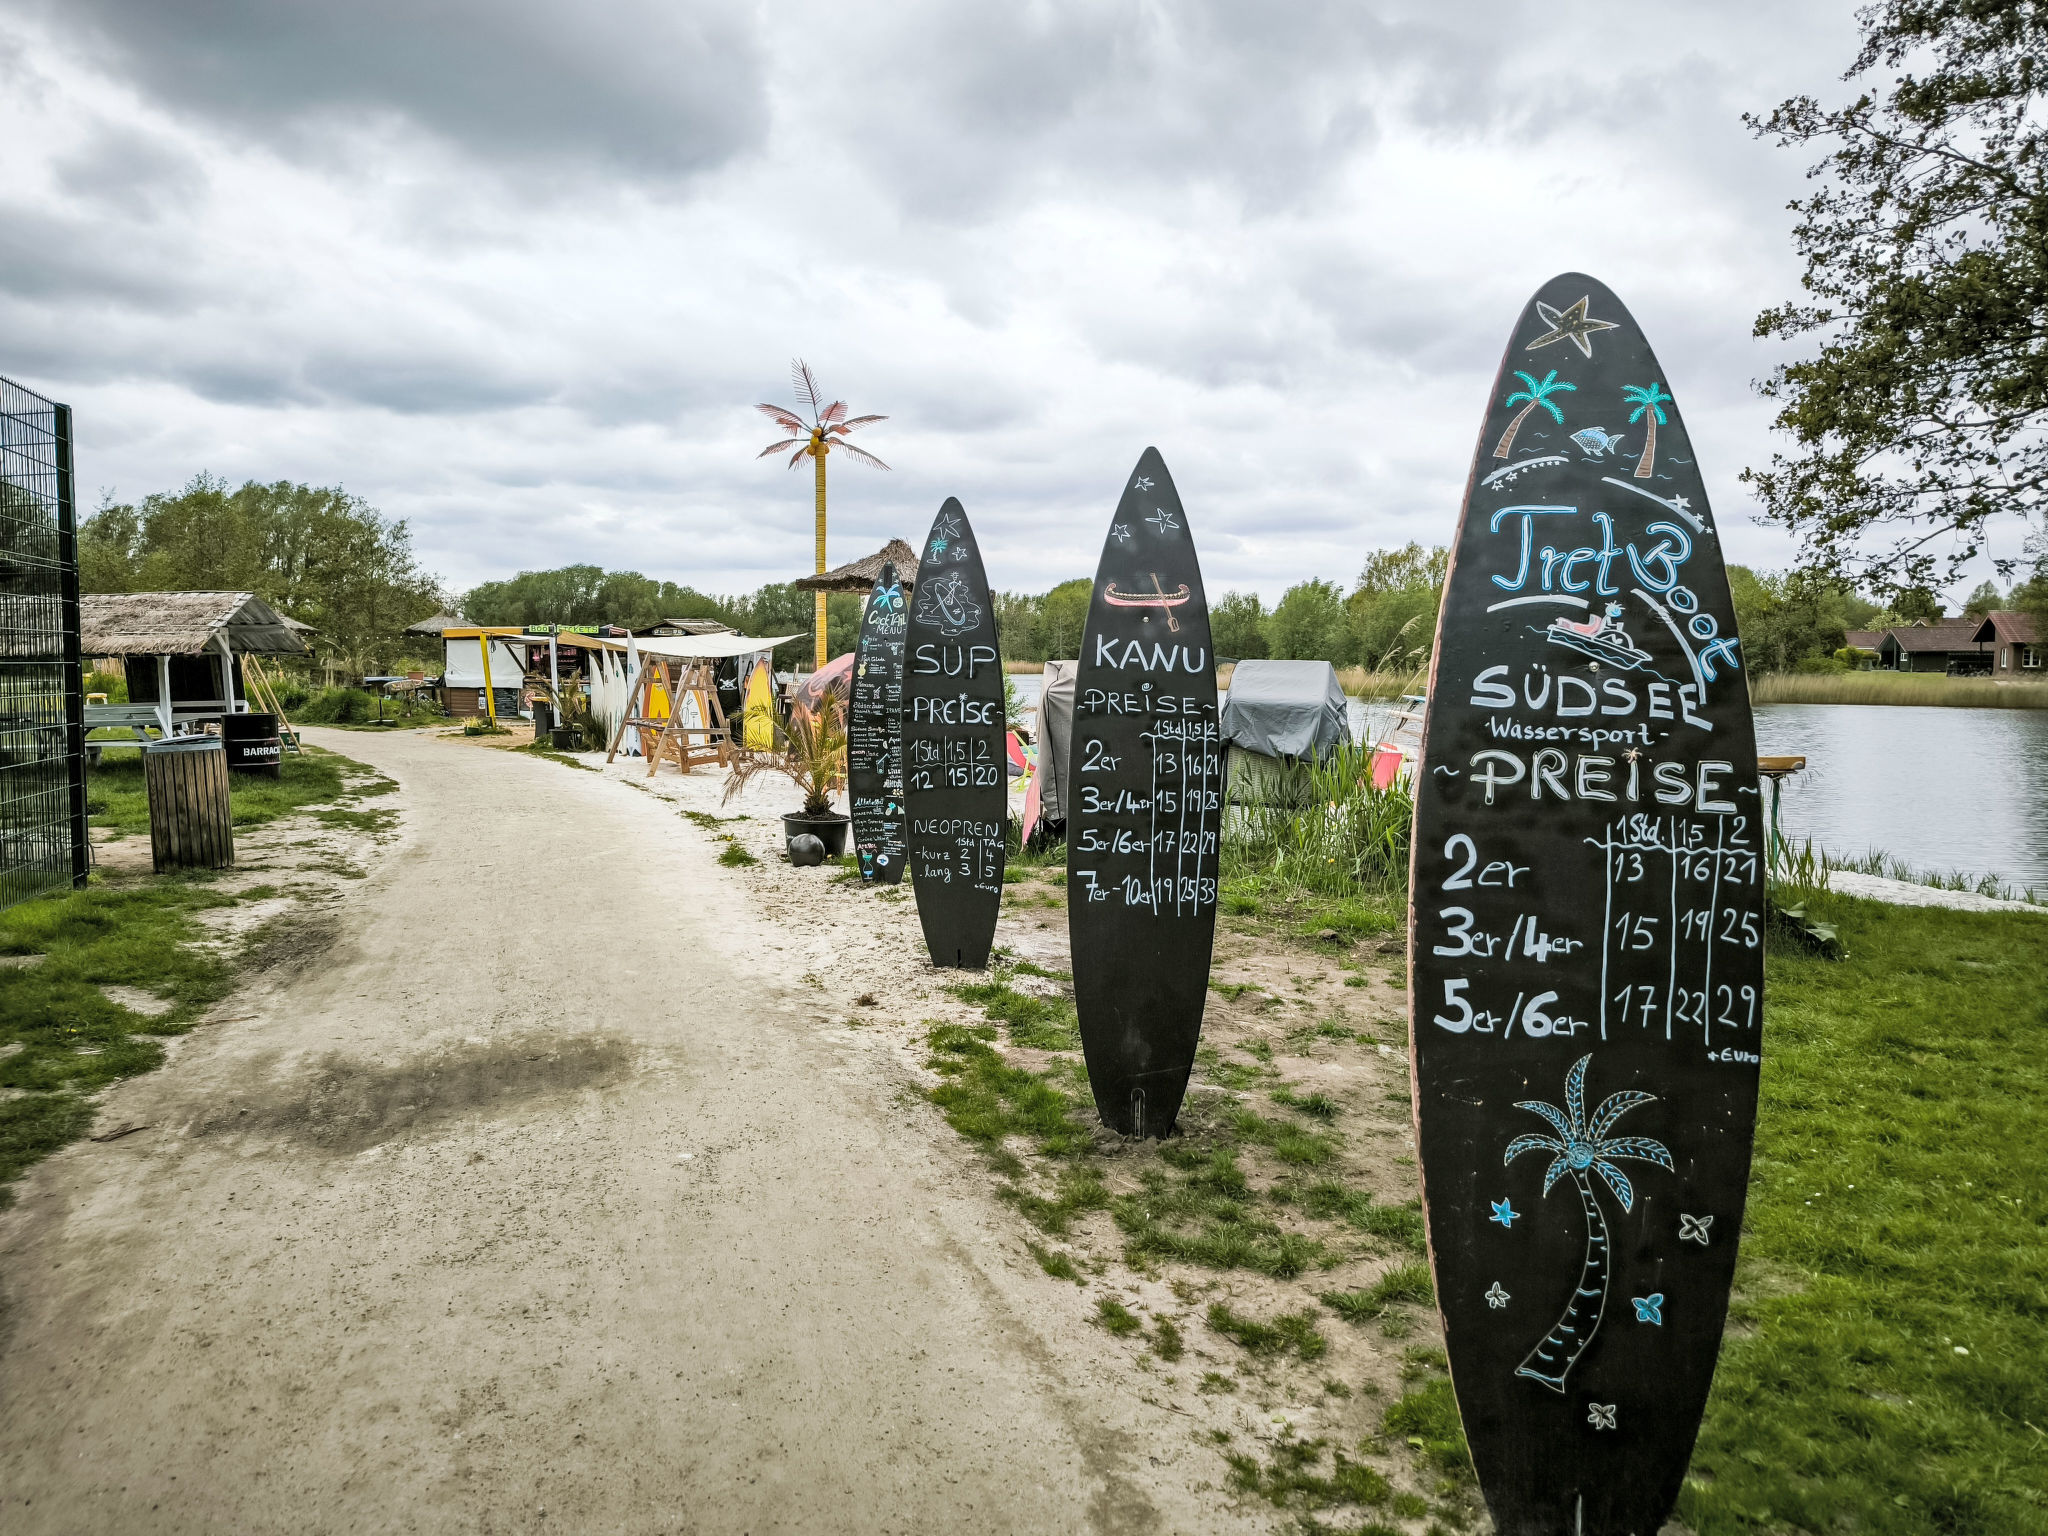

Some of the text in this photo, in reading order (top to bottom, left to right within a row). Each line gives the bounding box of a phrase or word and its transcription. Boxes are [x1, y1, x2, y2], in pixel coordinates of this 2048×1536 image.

[913, 643, 997, 679] SUP
[1095, 633, 1205, 674] KANU
[1470, 662, 1714, 732] SÜDSEE
[1207, 722, 1218, 737] 2
[947, 740, 967, 763] 1,5
[975, 739, 991, 760] 2
[1080, 739, 1122, 773] 2er
[1155, 752, 1178, 774] 13
[1186, 753, 1202, 776] 16
[1206, 753, 1219, 776] 21
[909, 770, 934, 790] 12
[948, 767, 968, 787] 15
[975, 766, 998, 786] 20
[1155, 789, 1177, 814] 15
[1186, 789, 1202, 814] 19
[1204, 790, 1219, 811] 25
[914, 818, 999, 837] NEOPREN
[1678, 818, 1706, 850] 1,5
[1729, 815, 1751, 845] 2
[959, 848, 971, 860] 2
[982, 838, 1005, 851] TAG
[1154, 831, 1176, 855] 17
[1182, 831, 1198, 854] 22
[1202, 830, 1216, 855] 29
[985, 849, 995, 863] 4
[1440, 832, 1531, 891] 2er
[1614, 852, 1645, 883] 13
[1680, 855, 1711, 882] 16
[958, 863, 971, 877] 3
[984, 865, 997, 879] 5
[1722, 856, 1757, 886] 21
[1154, 877, 1173, 904] 19
[1180, 875, 1197, 903] 25
[1199, 877, 1216, 905] 33
[1615, 911, 1660, 951] 15
[1680, 908, 1711, 943] 19
[1719, 907, 1760, 949] 25
[1613, 983, 1659, 1029] 17
[1674, 986, 1706, 1026] 22
[1716, 983, 1757, 1029] 29
